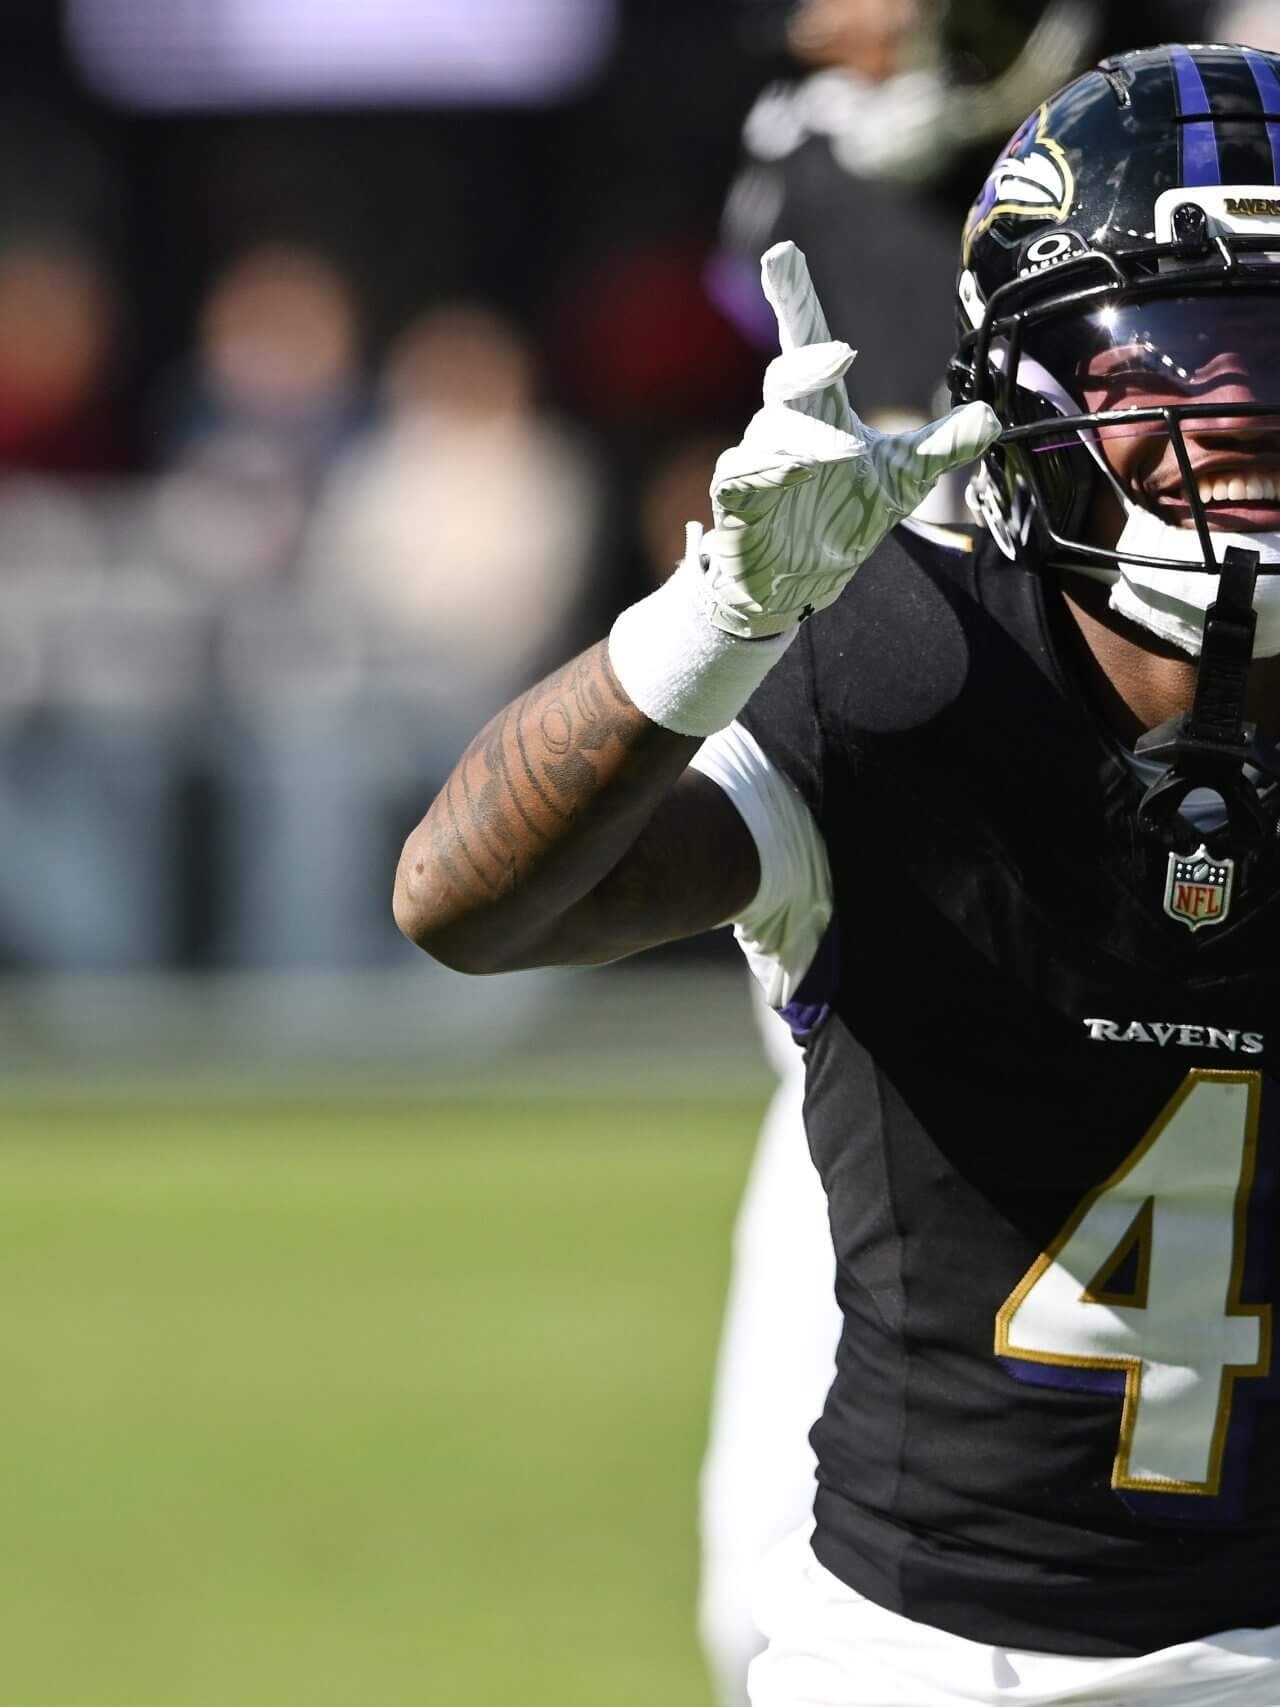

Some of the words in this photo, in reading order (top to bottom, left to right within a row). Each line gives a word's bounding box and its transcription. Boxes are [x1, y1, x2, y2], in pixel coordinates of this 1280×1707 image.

[1175, 884, 1220, 917] NFL
[1083, 1018, 1265, 1054] RAVENS
[994, 1067, 1273, 1497] 4
